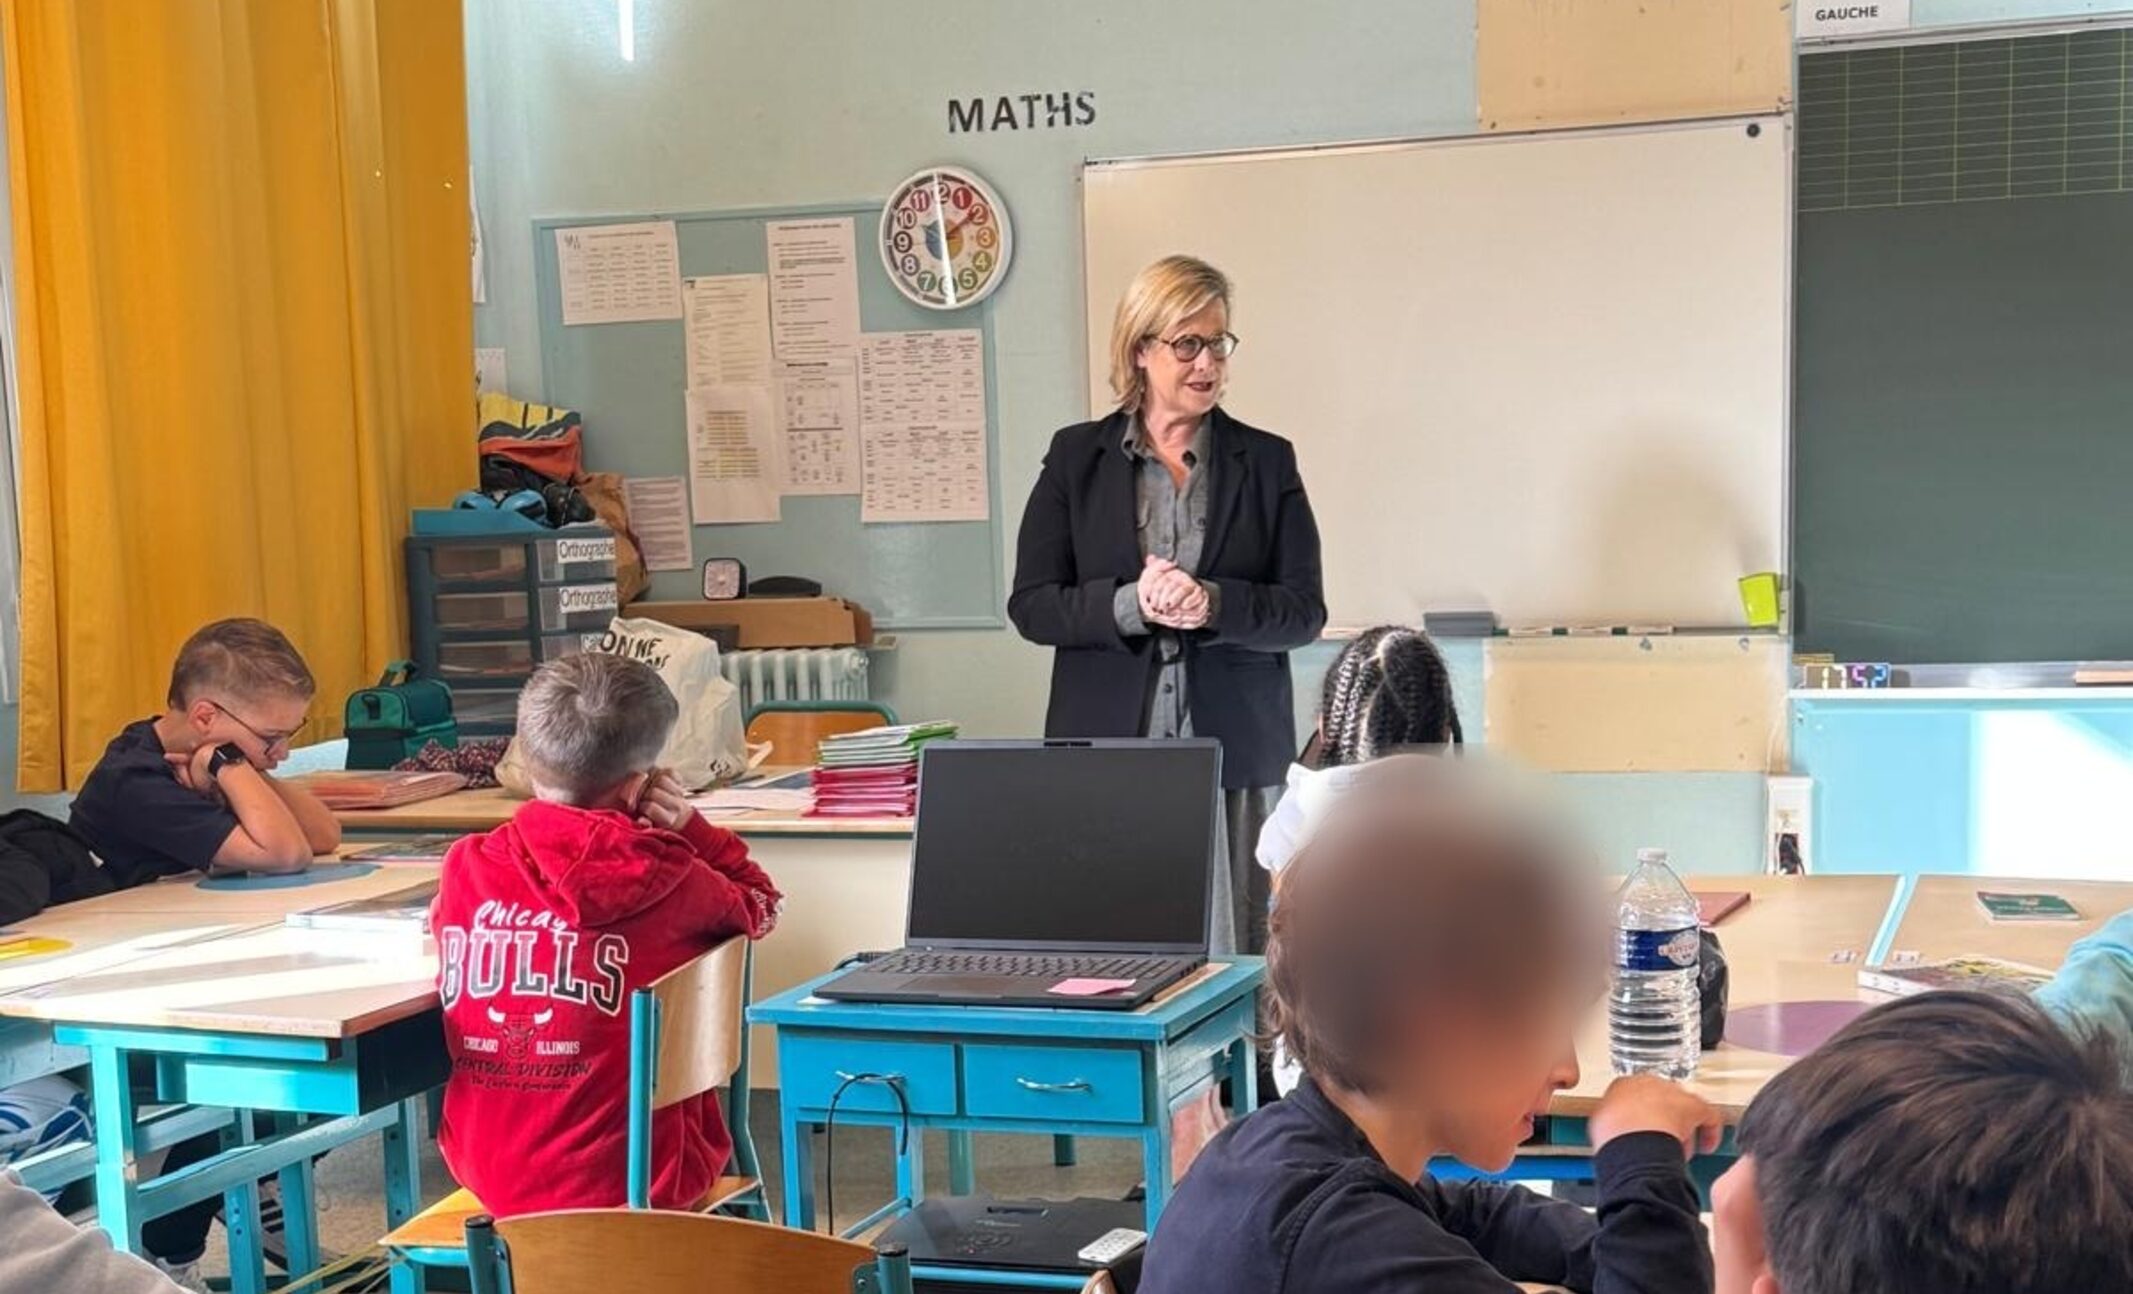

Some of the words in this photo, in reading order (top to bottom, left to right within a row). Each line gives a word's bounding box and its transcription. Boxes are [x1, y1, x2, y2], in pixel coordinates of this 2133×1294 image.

[1815, 6, 1879, 21] GAUCHE
[948, 91, 1096, 133] MATHS
[912, 191, 927, 210] 11
[898, 209, 915, 228] 10
[973, 205, 985, 223] 2
[897, 233, 909, 251] 9
[980, 228, 992, 246] 3
[905, 255, 916, 274] 8
[975, 253, 989, 271] 4
[921, 272, 932, 291] 7
[962, 270, 974, 288] 5
[559, 541, 615, 560] Orthographe
[561, 588, 616, 608] Orthographe
[440, 925, 629, 1017] BULLS
[463, 1035, 499, 1054] CHICAGO
[536, 1041, 580, 1055] ILLINOIS
[518, 1061, 593, 1078] DIVISION
